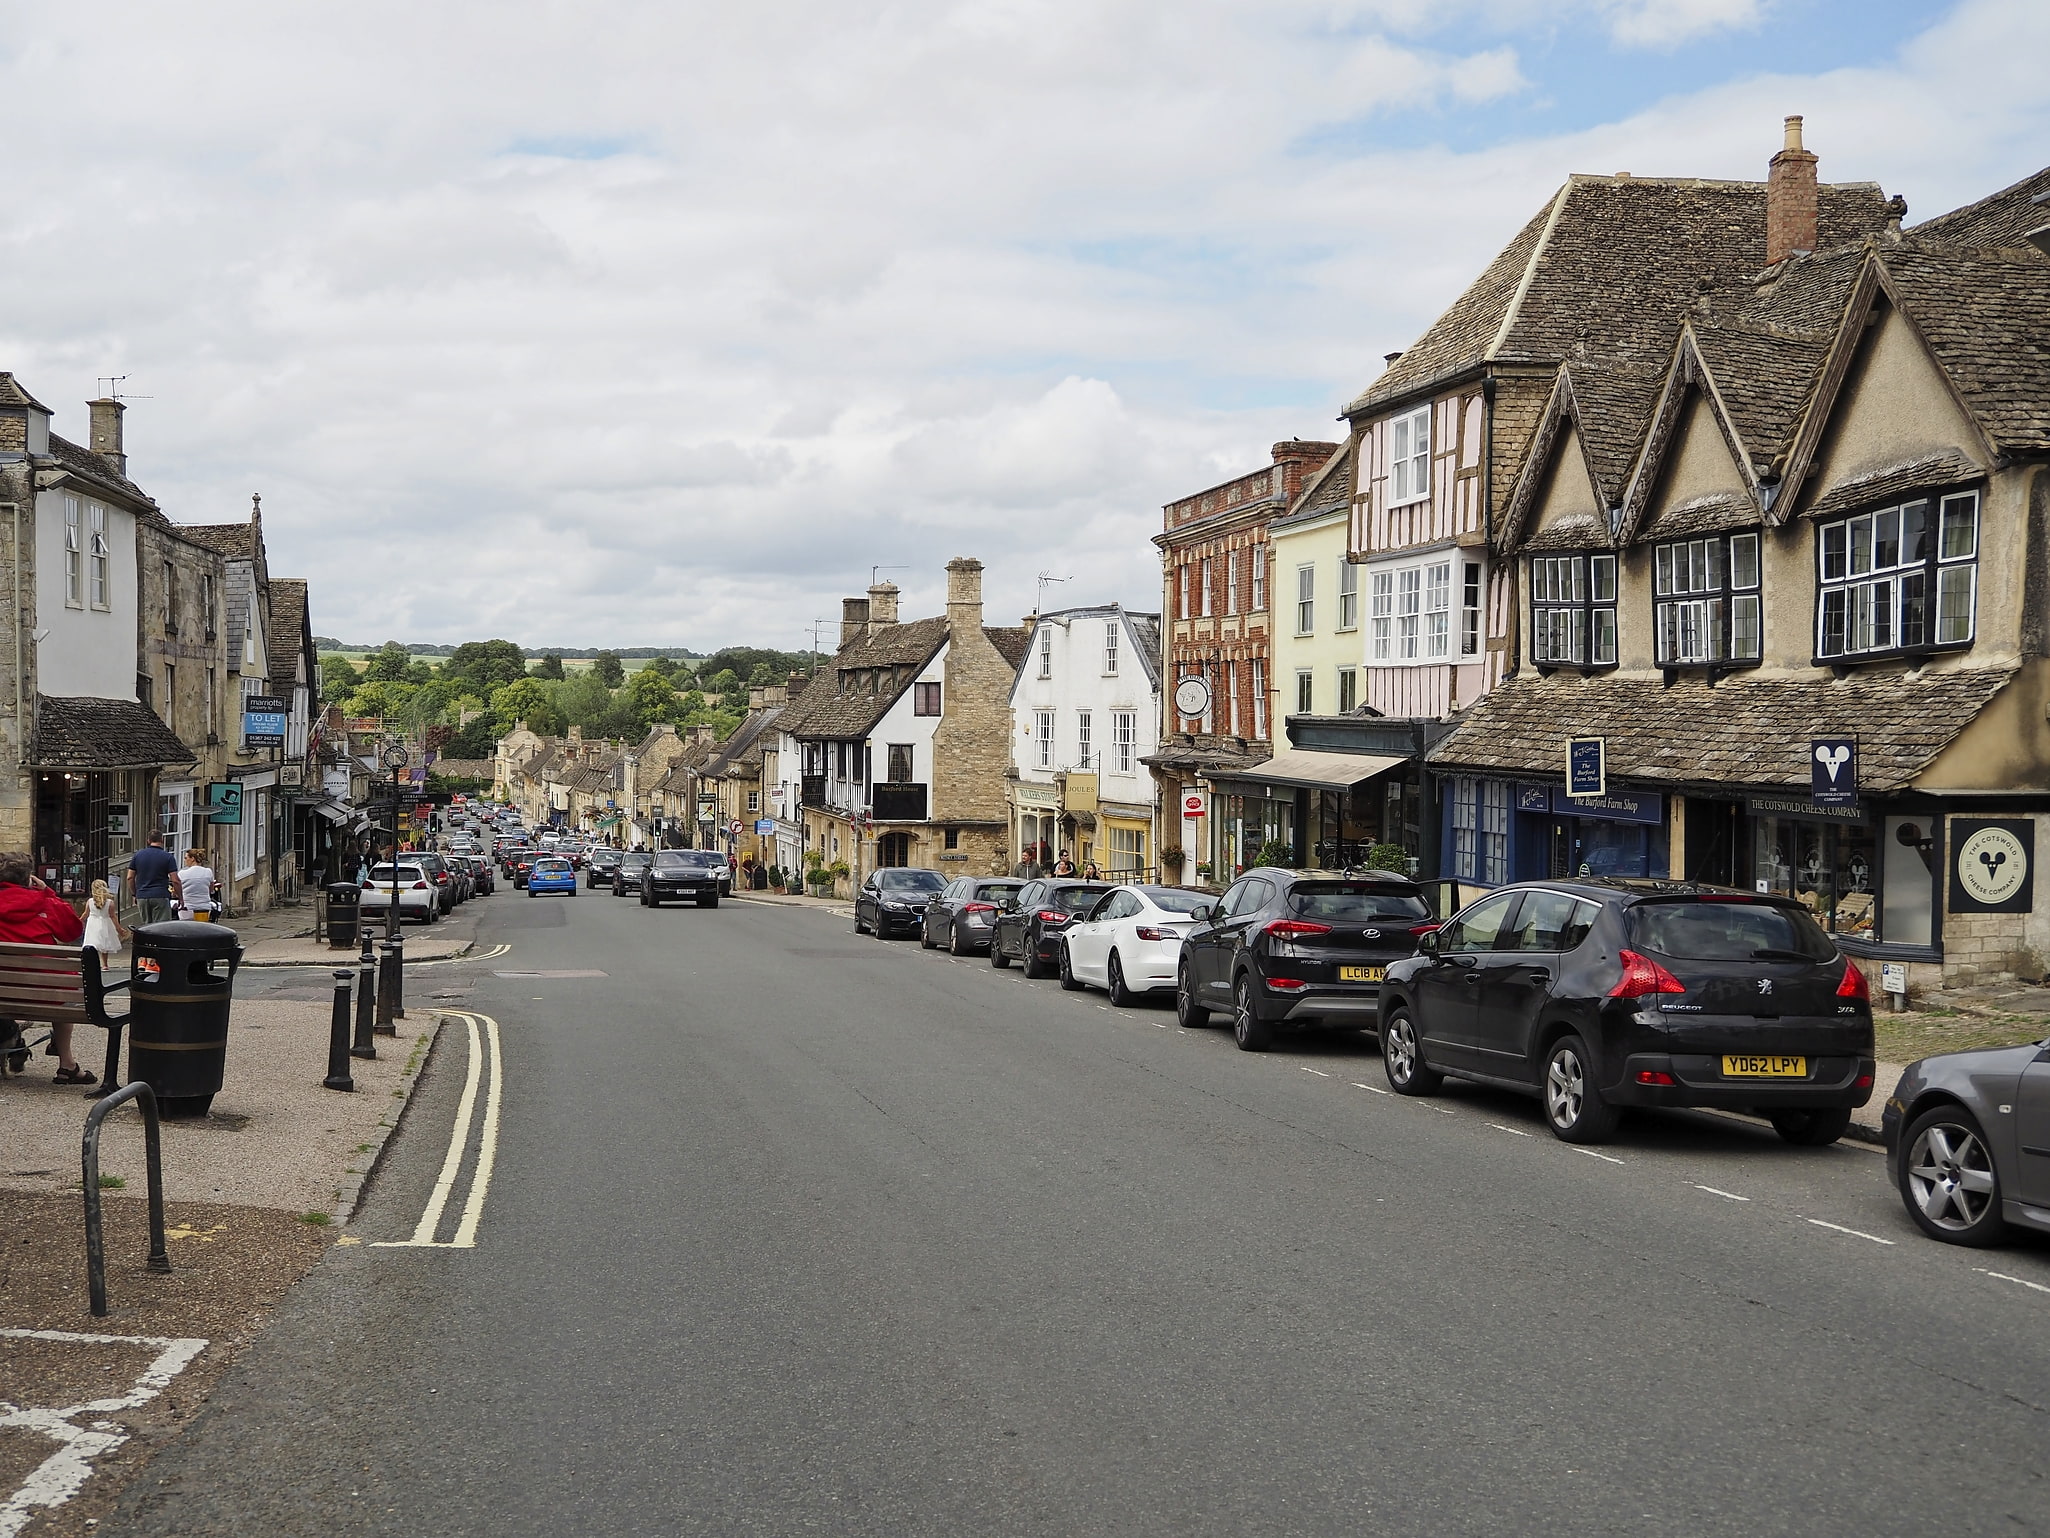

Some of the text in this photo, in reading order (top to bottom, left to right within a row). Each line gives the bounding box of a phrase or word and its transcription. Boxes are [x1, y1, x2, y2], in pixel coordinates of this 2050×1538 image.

[1574, 797, 1638, 813] The Burford Farm Shop
[1752, 799, 1861, 818] THE COTSWOLD CHEESE COMPANY
[1969, 835, 2017, 856] THE COTSWOLD
[1968, 874, 2016, 895] CHEESE COMPANY
[1347, 967, 1386, 978] LC18 AH
[1729, 1058, 1800, 1073] YD62 LPY
